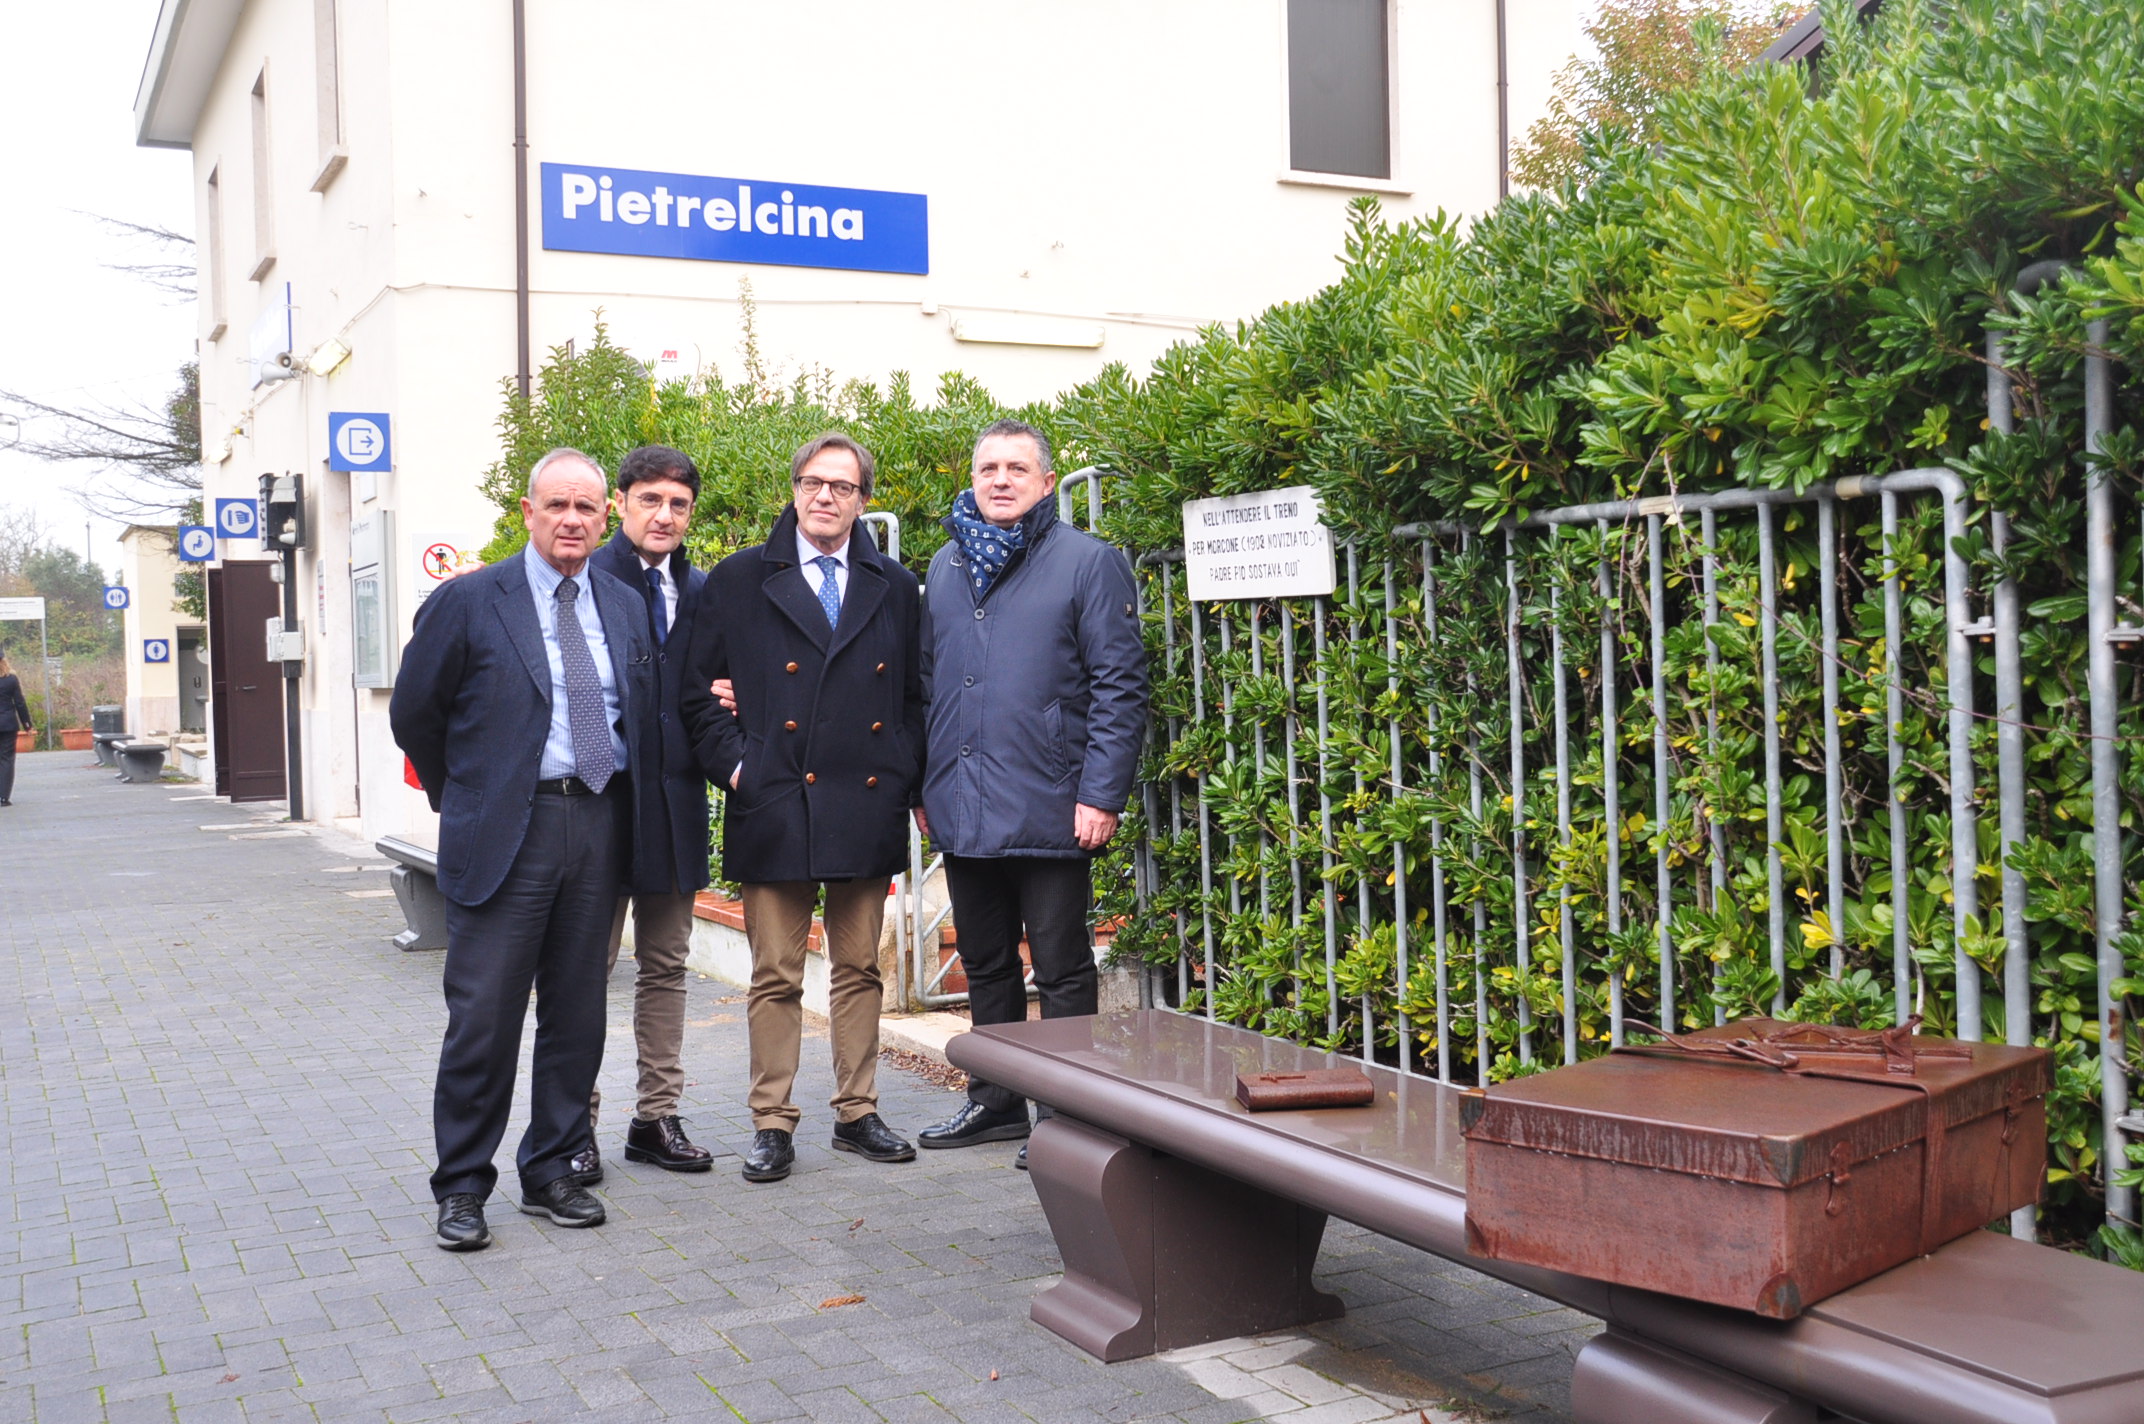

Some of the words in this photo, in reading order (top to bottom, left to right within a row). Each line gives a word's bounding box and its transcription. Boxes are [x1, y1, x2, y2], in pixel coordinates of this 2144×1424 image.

[561, 172, 865, 241] Pietrelcina
[1203, 506, 1262, 527] NELL'ATTENDERE
[1264, 505, 1271, 520] IL
[1274, 502, 1298, 519] TRENO
[1192, 541, 1205, 555] PER
[1207, 537, 1239, 554] MORCONE
[1210, 566, 1232, 582] PADRE
[1234, 565, 1246, 581] PIO
[1248, 562, 1283, 580] SOSTAVA
